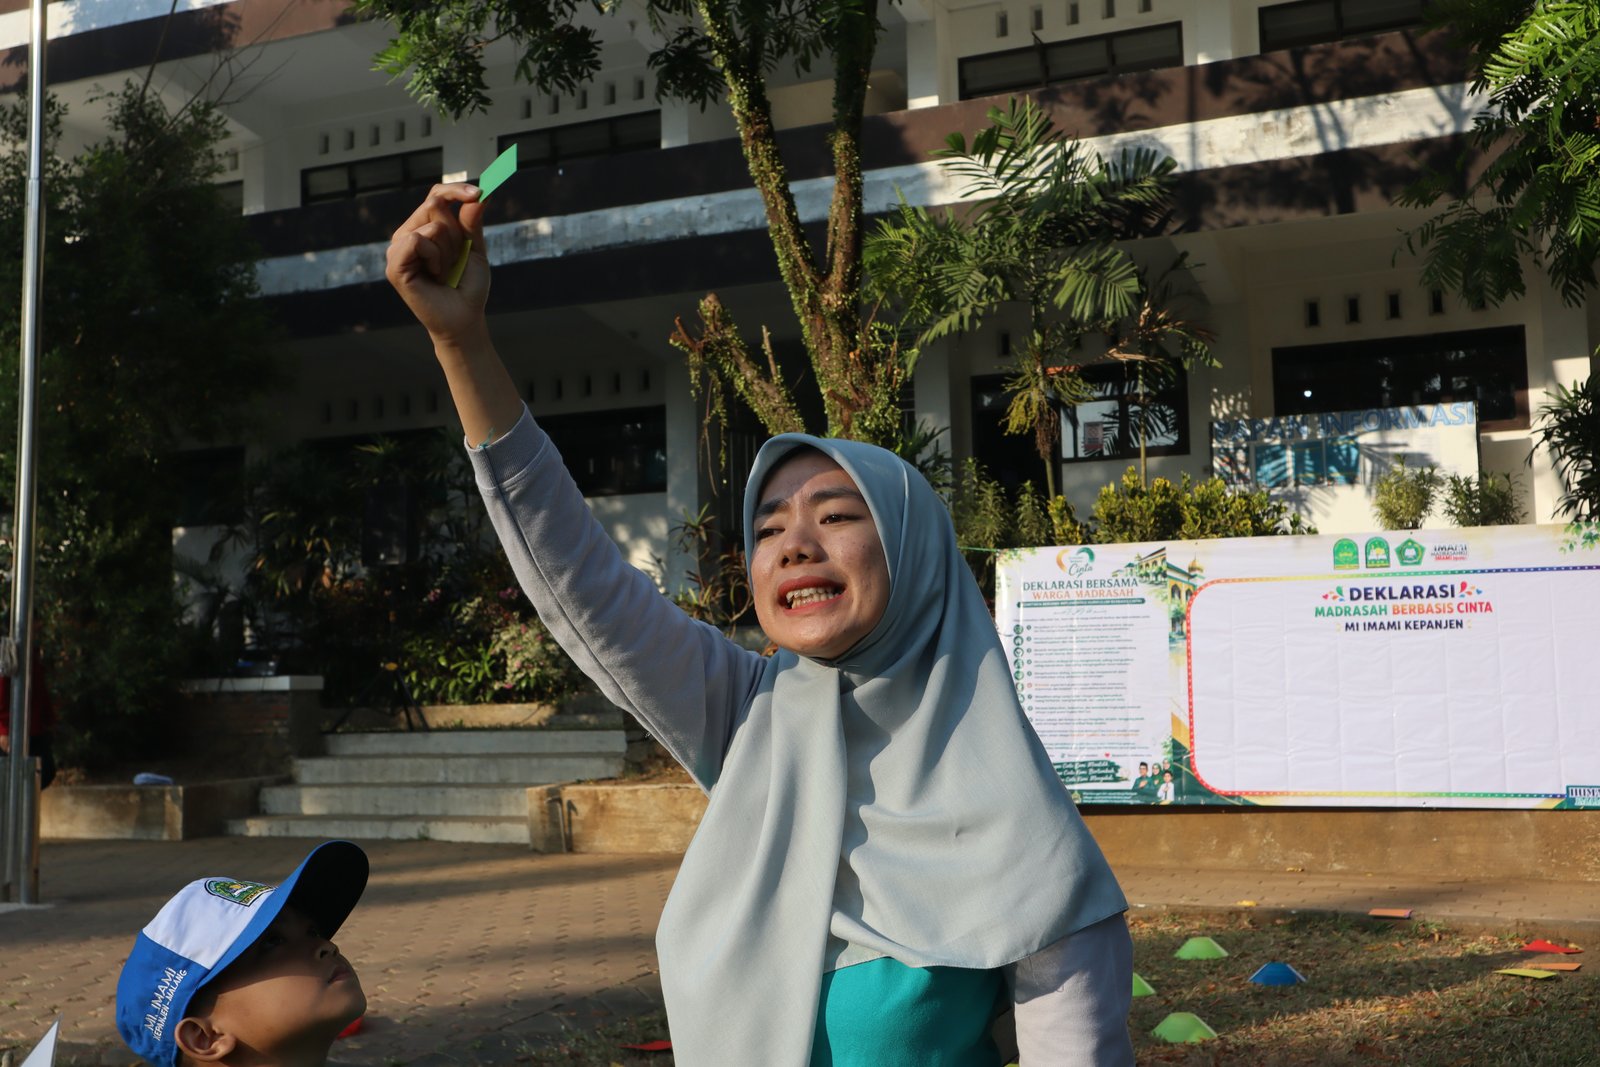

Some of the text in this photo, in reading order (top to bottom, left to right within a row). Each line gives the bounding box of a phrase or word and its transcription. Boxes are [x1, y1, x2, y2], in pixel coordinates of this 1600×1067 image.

[1317, 401, 1475, 436] INFORMASI
[1069, 562, 1093, 578] Cinta
[1023, 578, 1138, 591] DEKLARASI BERSAMA
[1349, 584, 1456, 601] DEKLARASI
[1032, 588, 1134, 600] WARGA MADRASAH
[1314, 601, 1493, 618] MADRASAH BERBASIS CINTA
[1345, 618, 1464, 632] MI IMAMI KEPANJEN
[151, 967, 177, 1010] IMAMI
